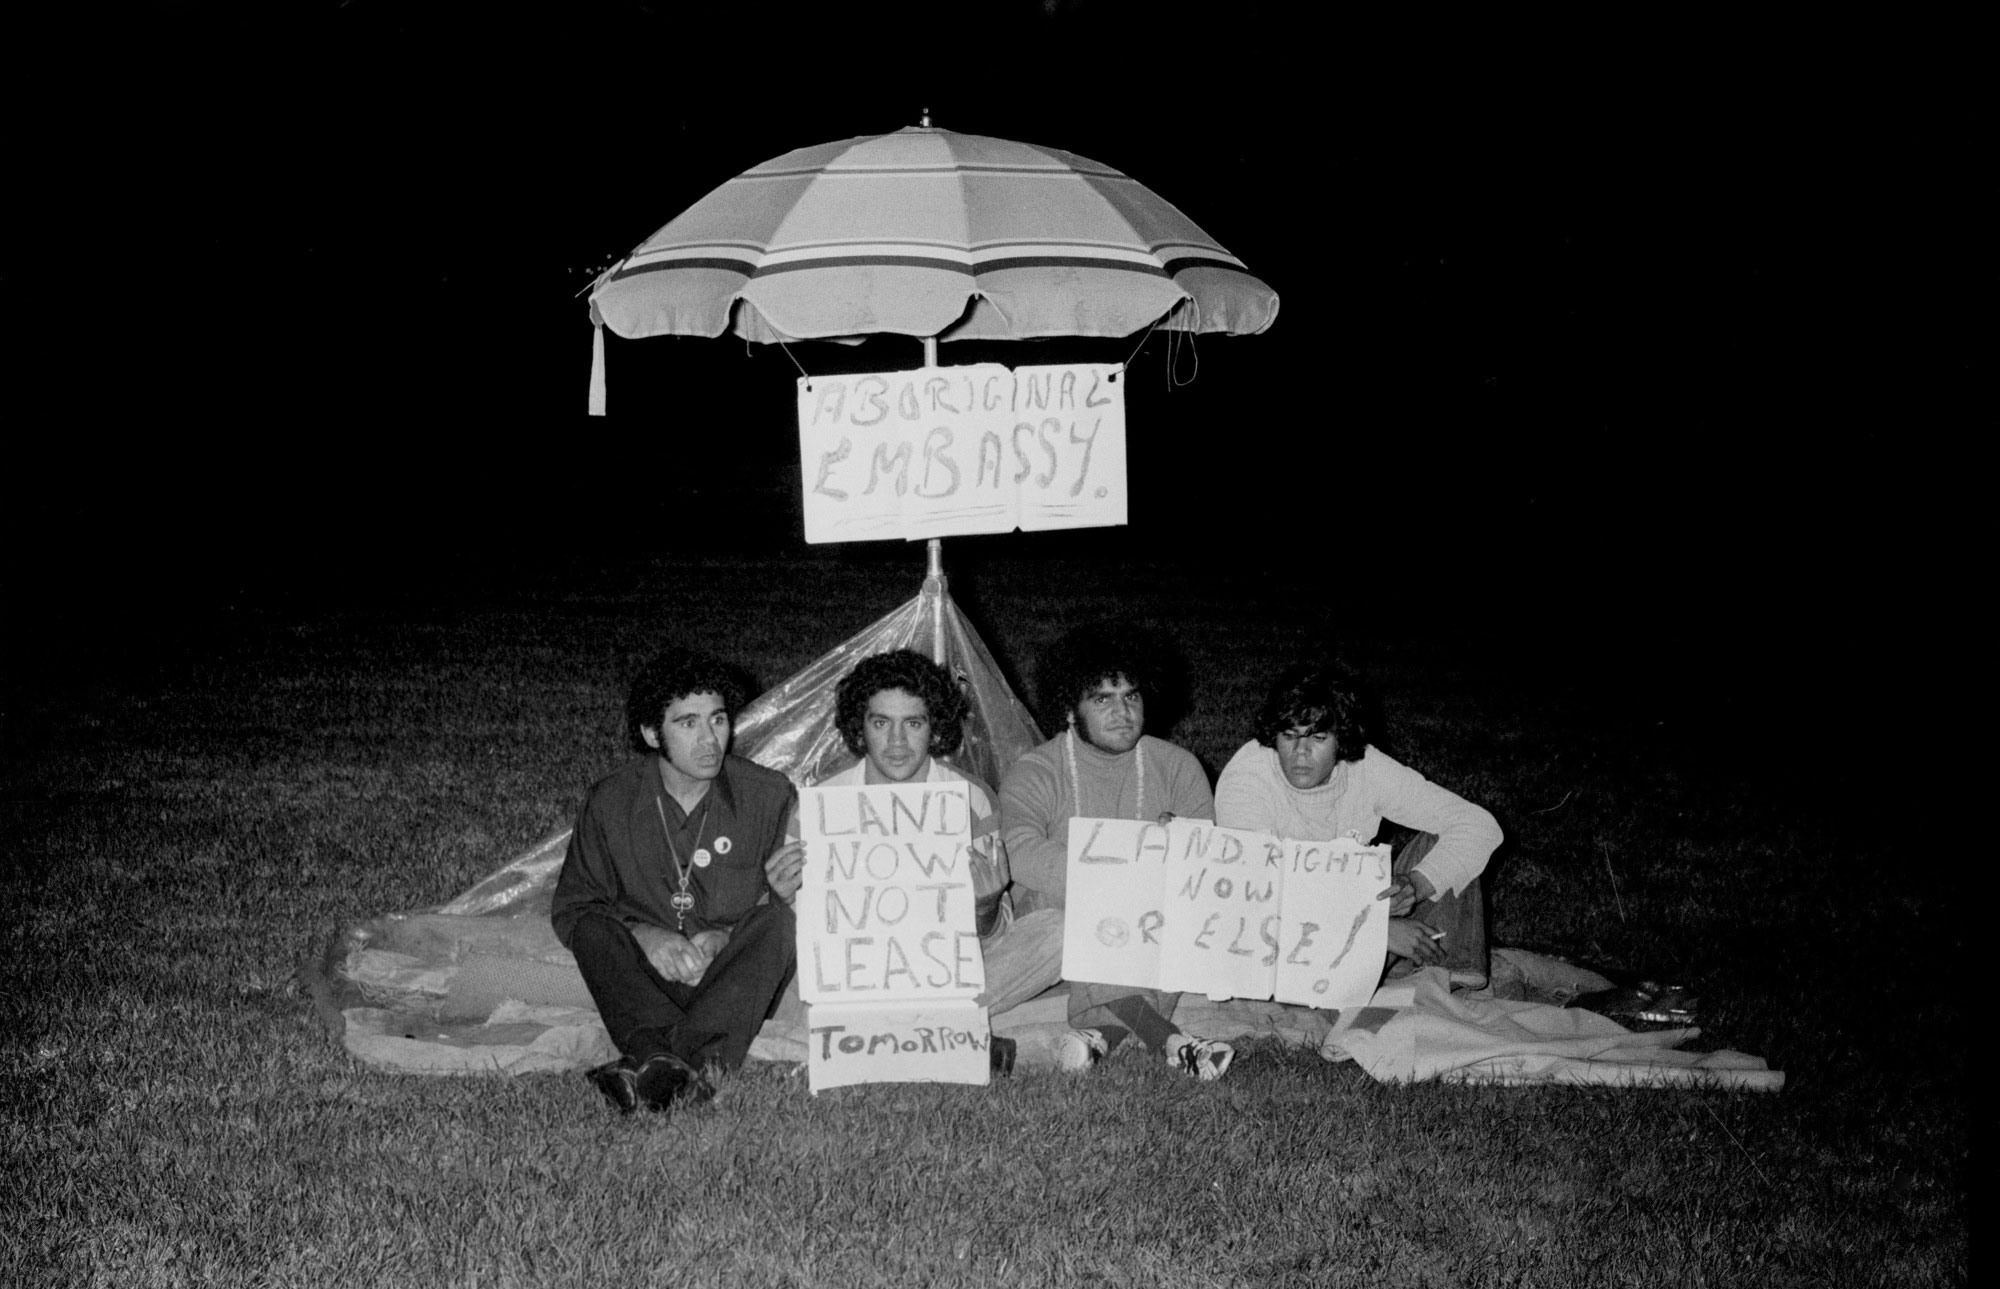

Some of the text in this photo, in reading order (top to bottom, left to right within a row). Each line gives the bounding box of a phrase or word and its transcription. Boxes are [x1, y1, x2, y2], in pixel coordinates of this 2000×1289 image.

[811, 368, 1112, 427] ABORIGINAL
[815, 788, 969, 837] LAND
[824, 840, 966, 883] NOW
[1178, 867, 1274, 902] NOW
[1263, 842, 1387, 881] RIGHTS
[824, 883, 967, 934] NOT
[813, 930, 984, 993] LEASE
[1095, 903, 1372, 995] OR ELSE!
